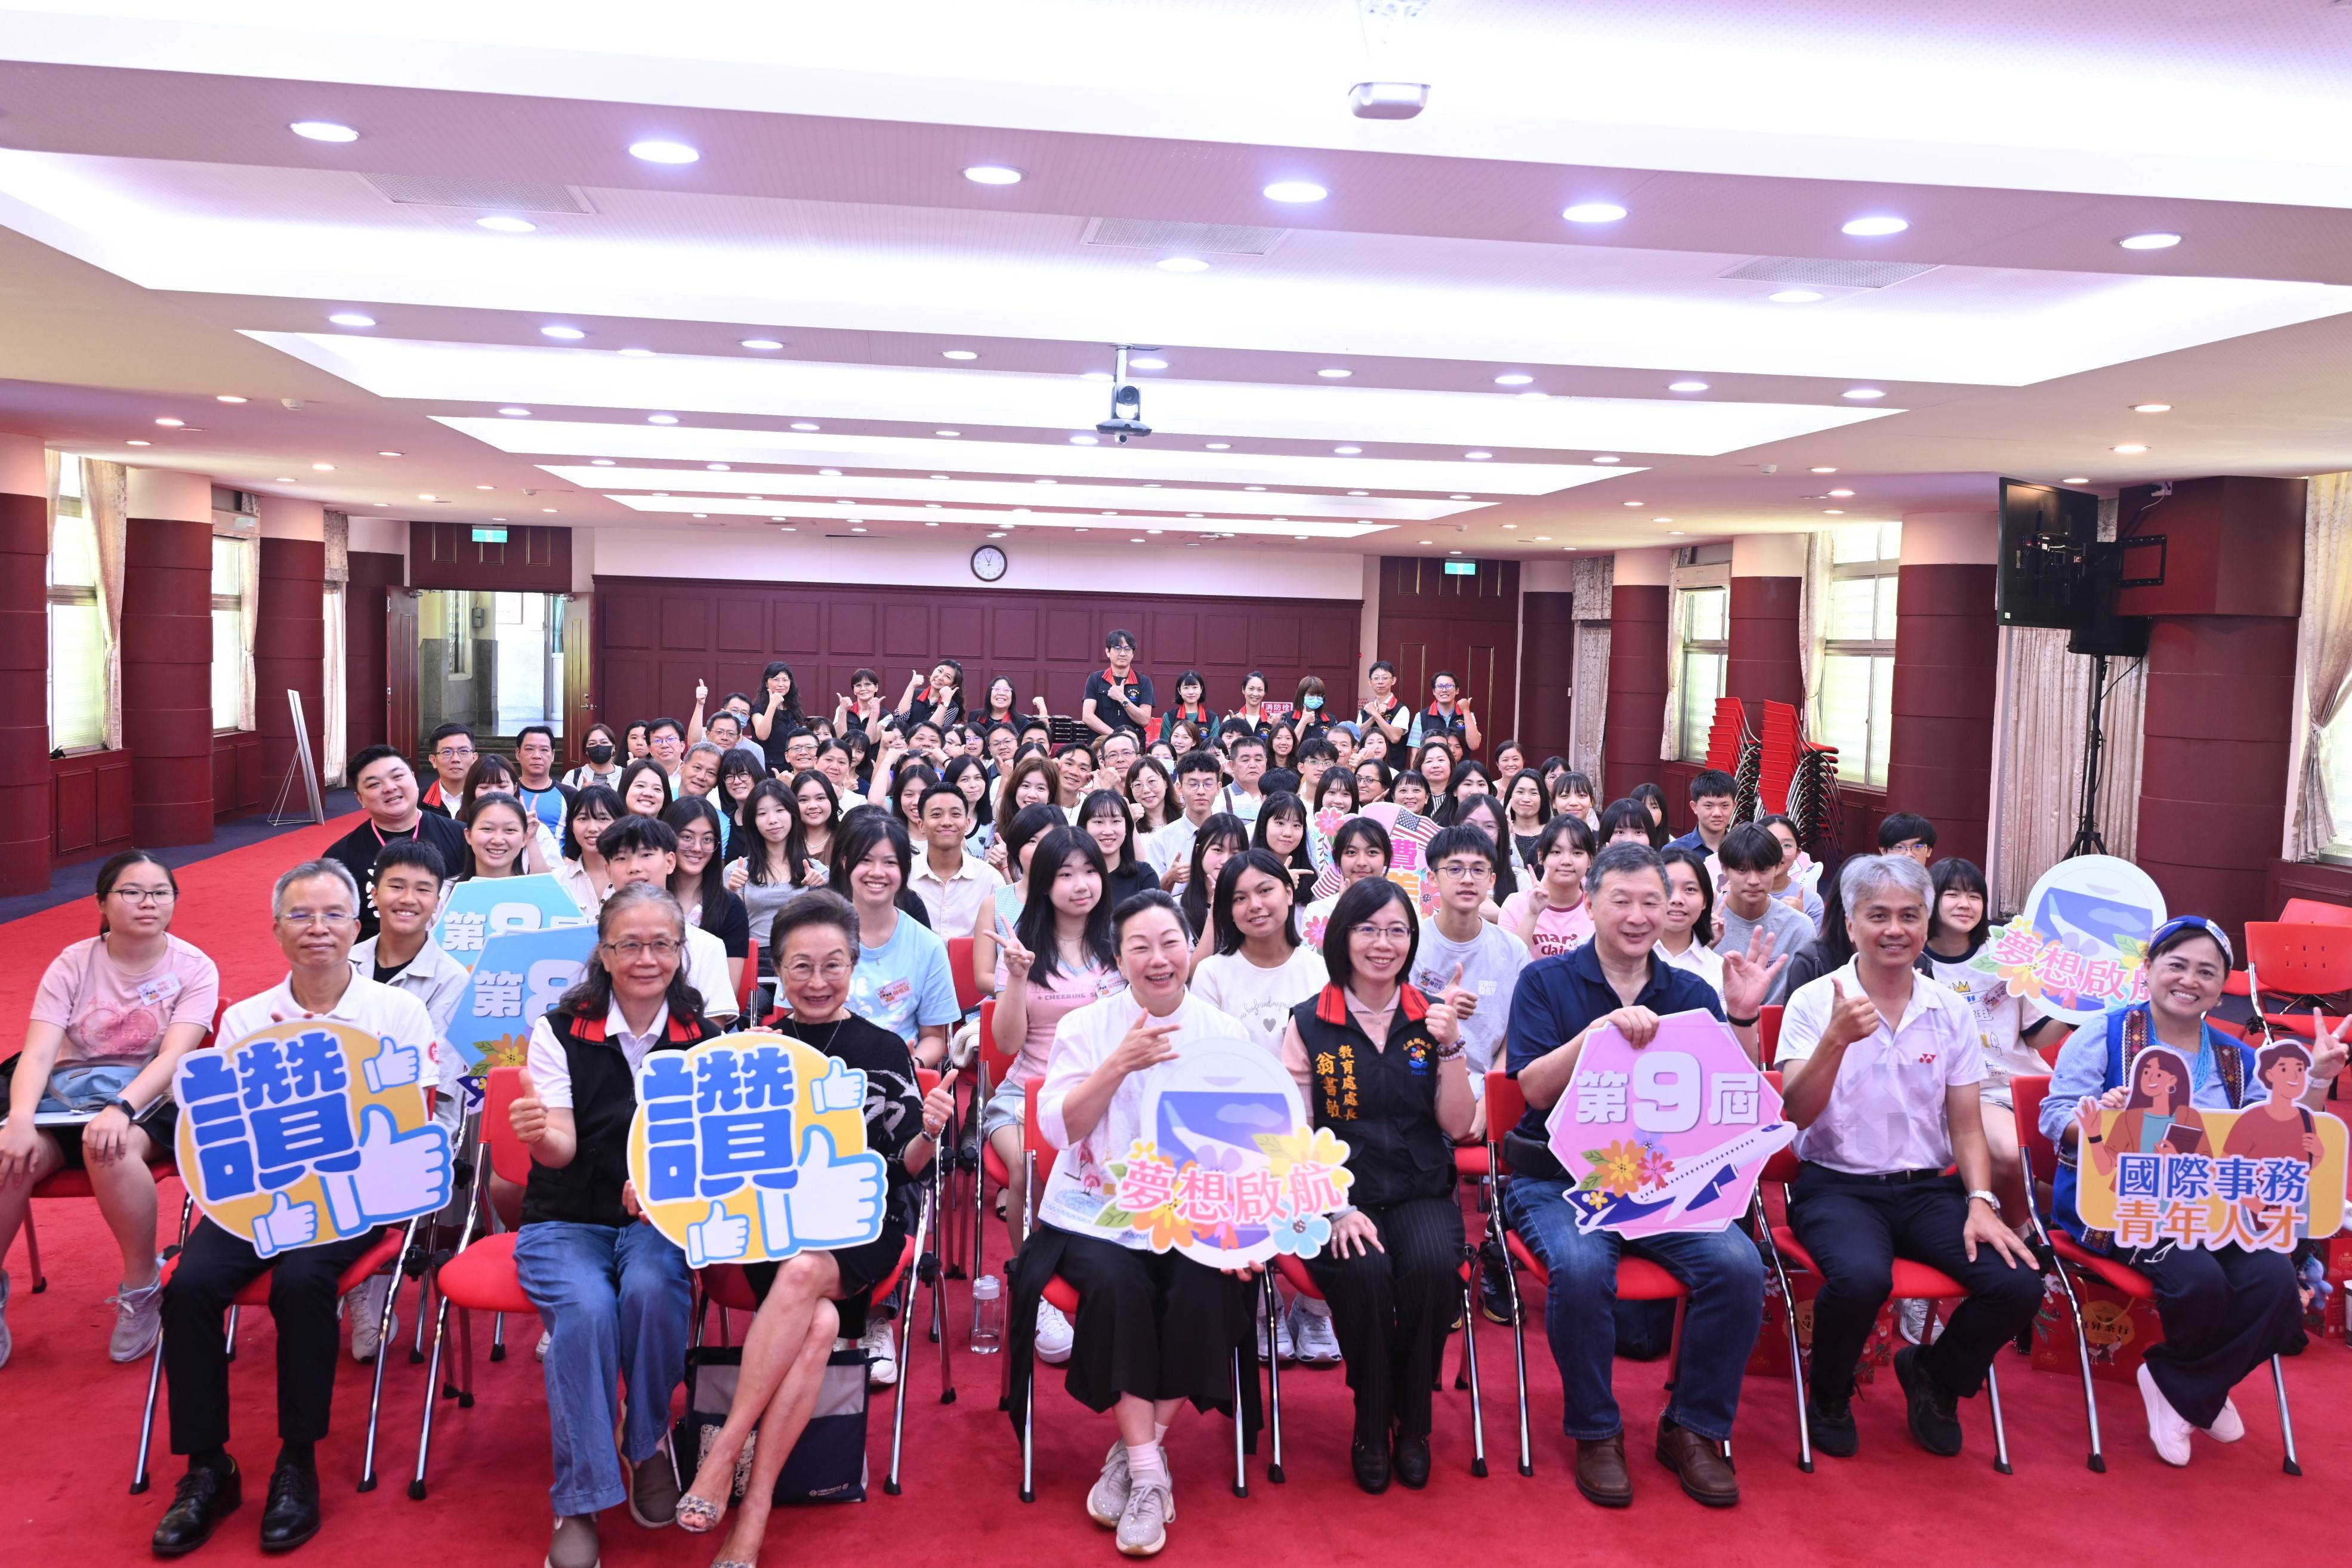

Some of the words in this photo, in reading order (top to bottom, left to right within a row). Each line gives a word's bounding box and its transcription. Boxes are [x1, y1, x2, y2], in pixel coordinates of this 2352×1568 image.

[1479, 986, 1496, 996] DAY
[181, 1032, 361, 1201] 讚
[1338, 1045, 1359, 1122] 教育處處長
[1575, 1051, 1759, 1133] 第9屆
[643, 1045, 799, 1202] 讚
[1119, 1160, 1343, 1223] 夢想啟航
[2119, 1156, 2307, 1203] 國際事務
[2116, 1200, 2304, 1248] 青年人才
